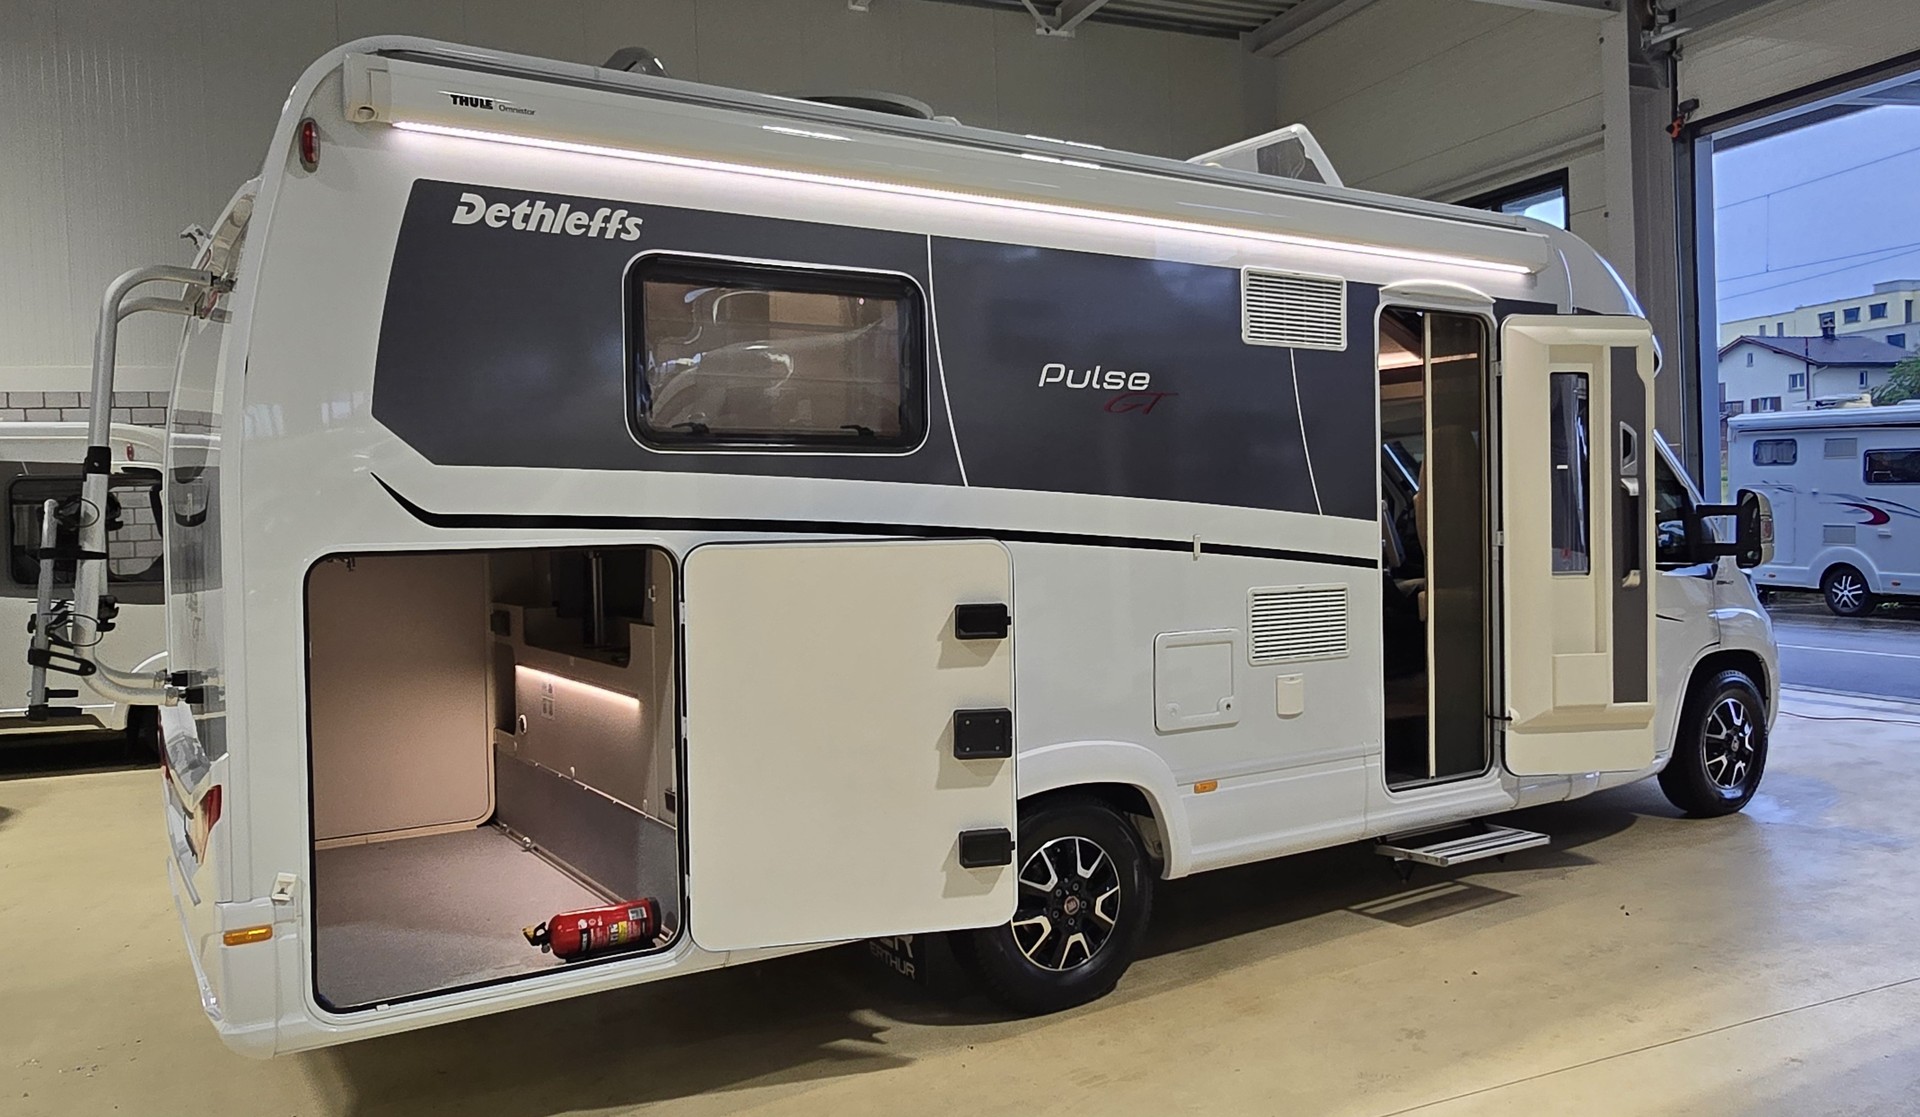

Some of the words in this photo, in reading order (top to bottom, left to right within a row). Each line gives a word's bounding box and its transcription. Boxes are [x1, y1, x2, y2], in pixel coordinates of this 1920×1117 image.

[450, 94, 493, 110] THULE
[498, 103, 536, 116] Omnistor
[452, 192, 643, 242] Dethleffs
[1038, 363, 1151, 391] Pulse
[1103, 391, 1179, 416] GT
